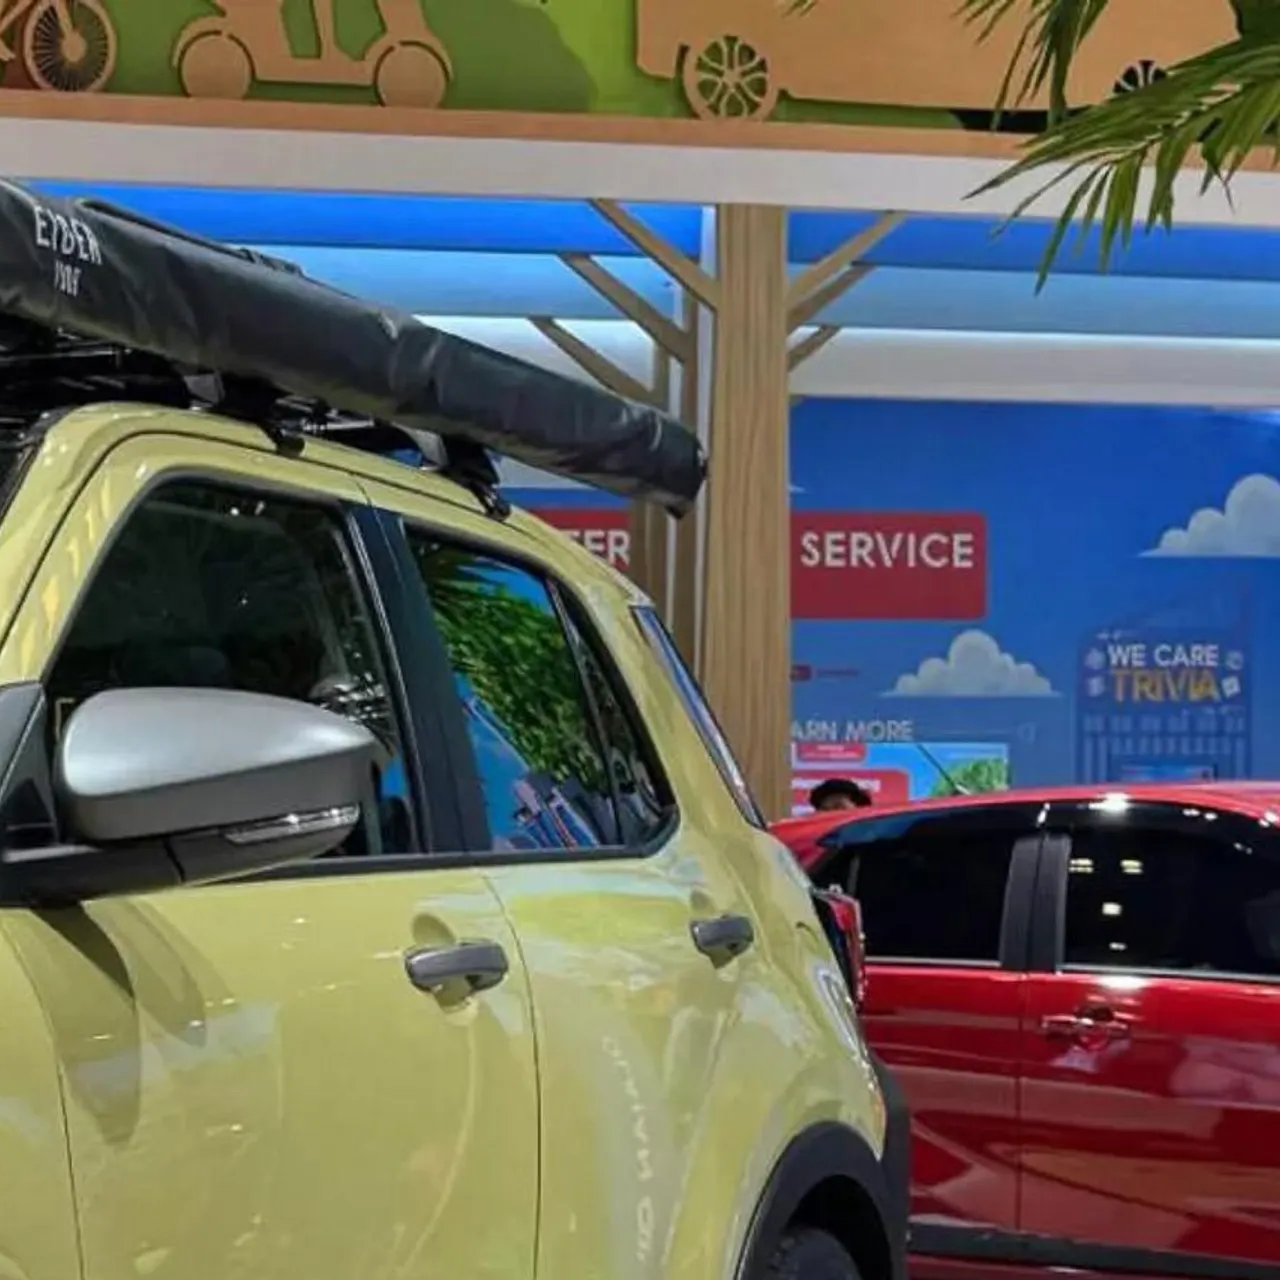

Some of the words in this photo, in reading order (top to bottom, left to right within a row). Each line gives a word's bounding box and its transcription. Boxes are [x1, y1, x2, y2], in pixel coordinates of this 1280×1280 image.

[559, 528, 631, 566] ER
[800, 531, 974, 570] SERVICE
[1107, 644, 1146, 667] WE
[1154, 644, 1219, 668] CARE
[1110, 668, 1223, 702] TRIVIA
[845, 720, 914, 741] MORE
